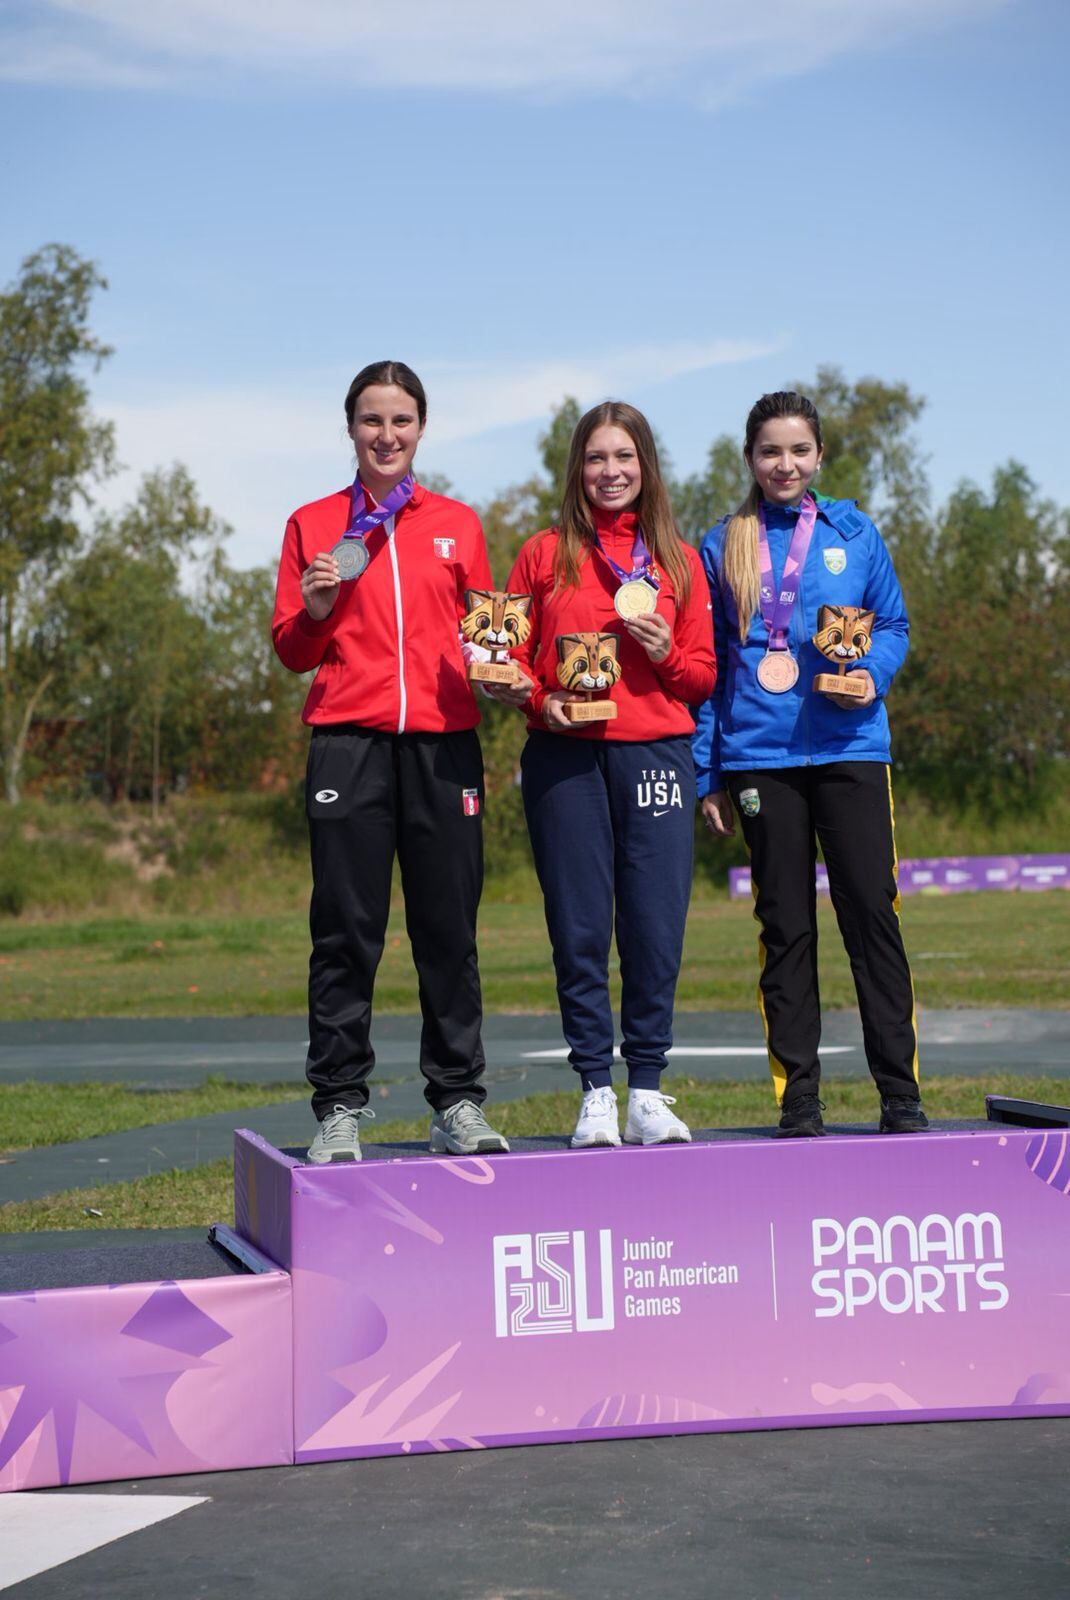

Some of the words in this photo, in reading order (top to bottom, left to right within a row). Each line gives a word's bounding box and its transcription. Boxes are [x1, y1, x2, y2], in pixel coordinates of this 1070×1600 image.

[641, 769, 676, 781] TEAM
[637, 782, 683, 808] USA
[622, 1237, 674, 1262] Junior
[812, 1212, 1003, 1267] PANAM
[624, 1266, 655, 1289] Pan
[659, 1262, 738, 1288] American
[811, 1263, 1009, 1318] SPORTS
[625, 1294, 682, 1318] Games
